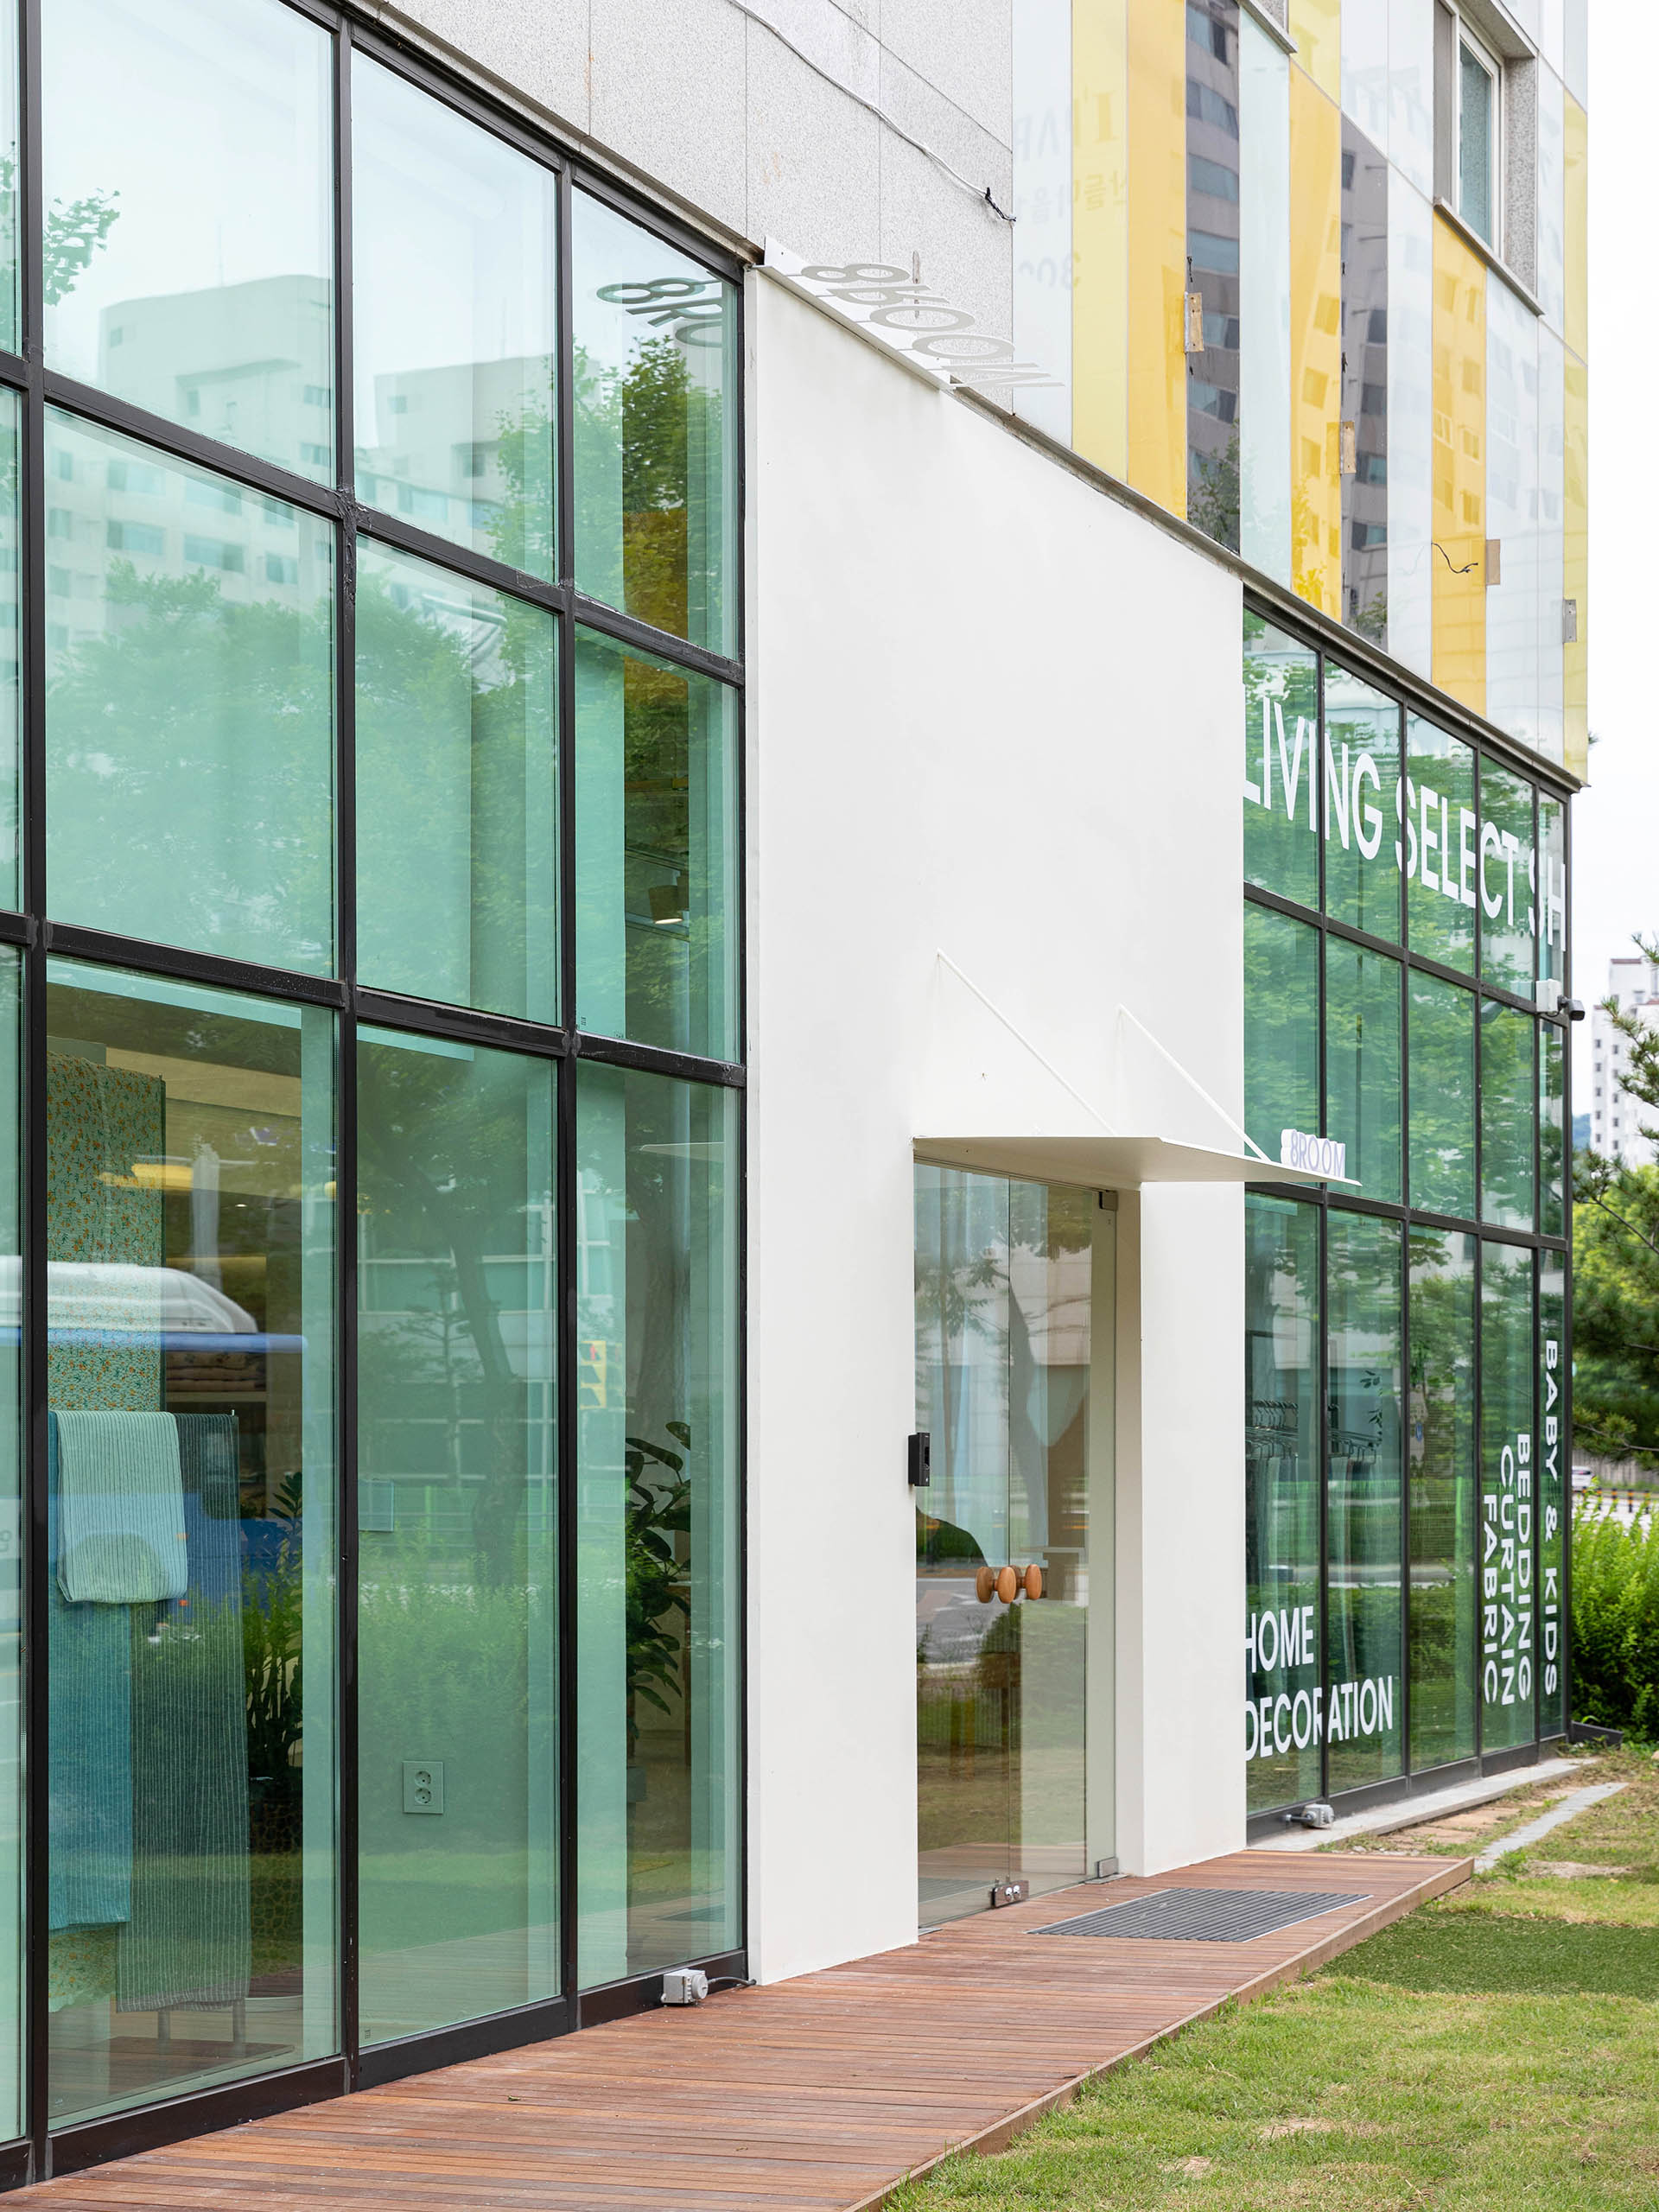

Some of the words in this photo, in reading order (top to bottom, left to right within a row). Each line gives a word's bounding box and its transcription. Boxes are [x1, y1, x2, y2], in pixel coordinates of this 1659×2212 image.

[1395, 776, 1519, 926] SELECT
[1285, 1128, 1345, 1179] 8ROOM
[1545, 1340, 1558, 1482] BABY
[1500, 1445, 1514, 1706] CURTAIN
[1517, 1433, 1531, 1700] BEDDING
[1545, 1505, 1557, 1541] &
[1245, 1605, 1314, 1674] HOME
[1484, 1494, 1497, 1704] FABRIC
[1544, 1567, 1558, 1696] KIDS
[1245, 1675, 1393, 1761] DECORATION
